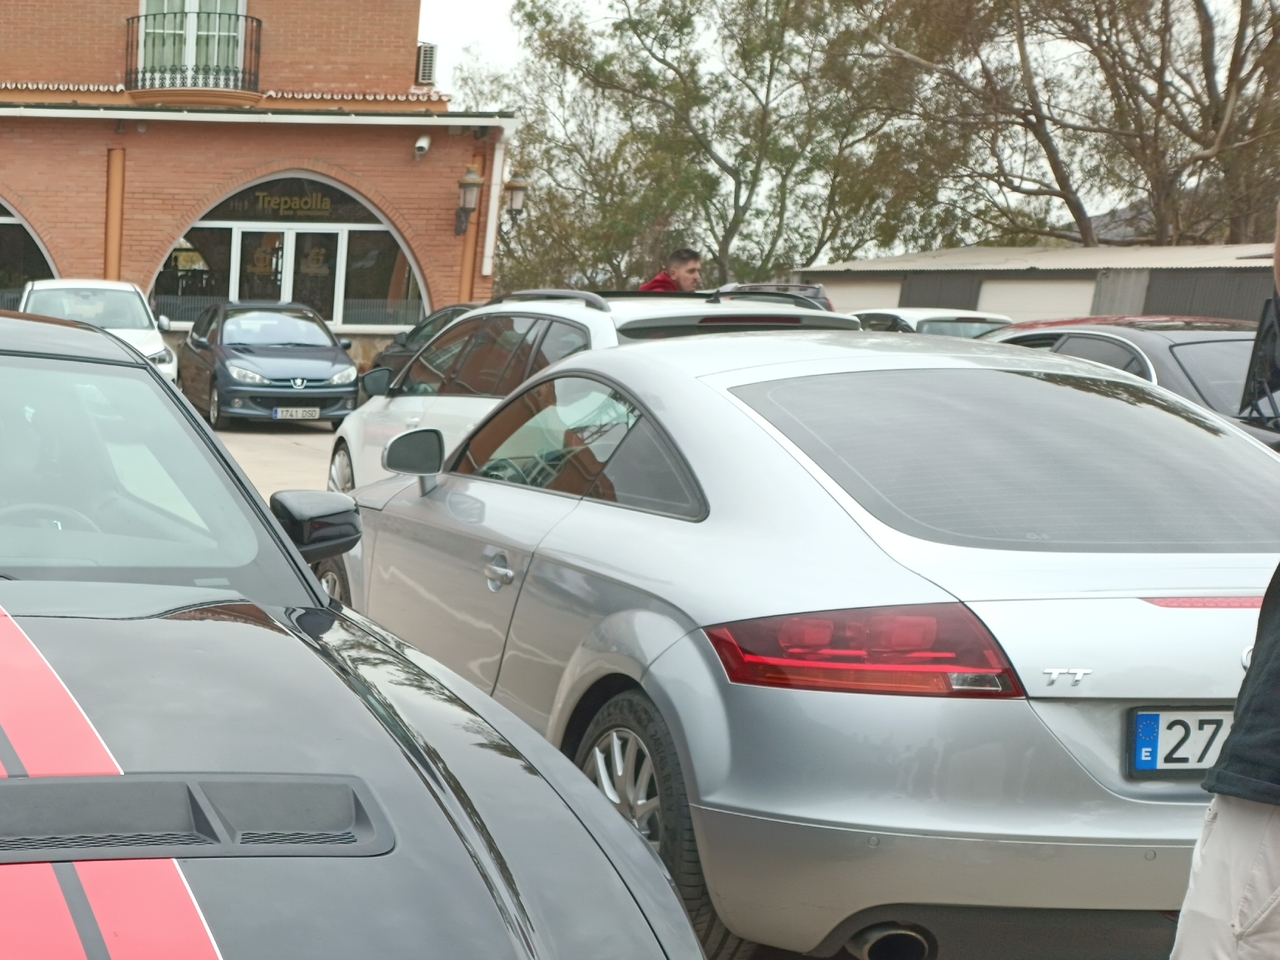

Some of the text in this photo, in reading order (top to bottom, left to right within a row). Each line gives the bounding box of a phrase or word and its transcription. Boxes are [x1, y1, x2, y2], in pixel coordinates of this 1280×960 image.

[255, 192, 331, 215] Trepaolla
[1043, 668, 1093, 686] TT
[1141, 747, 1152, 760] E
